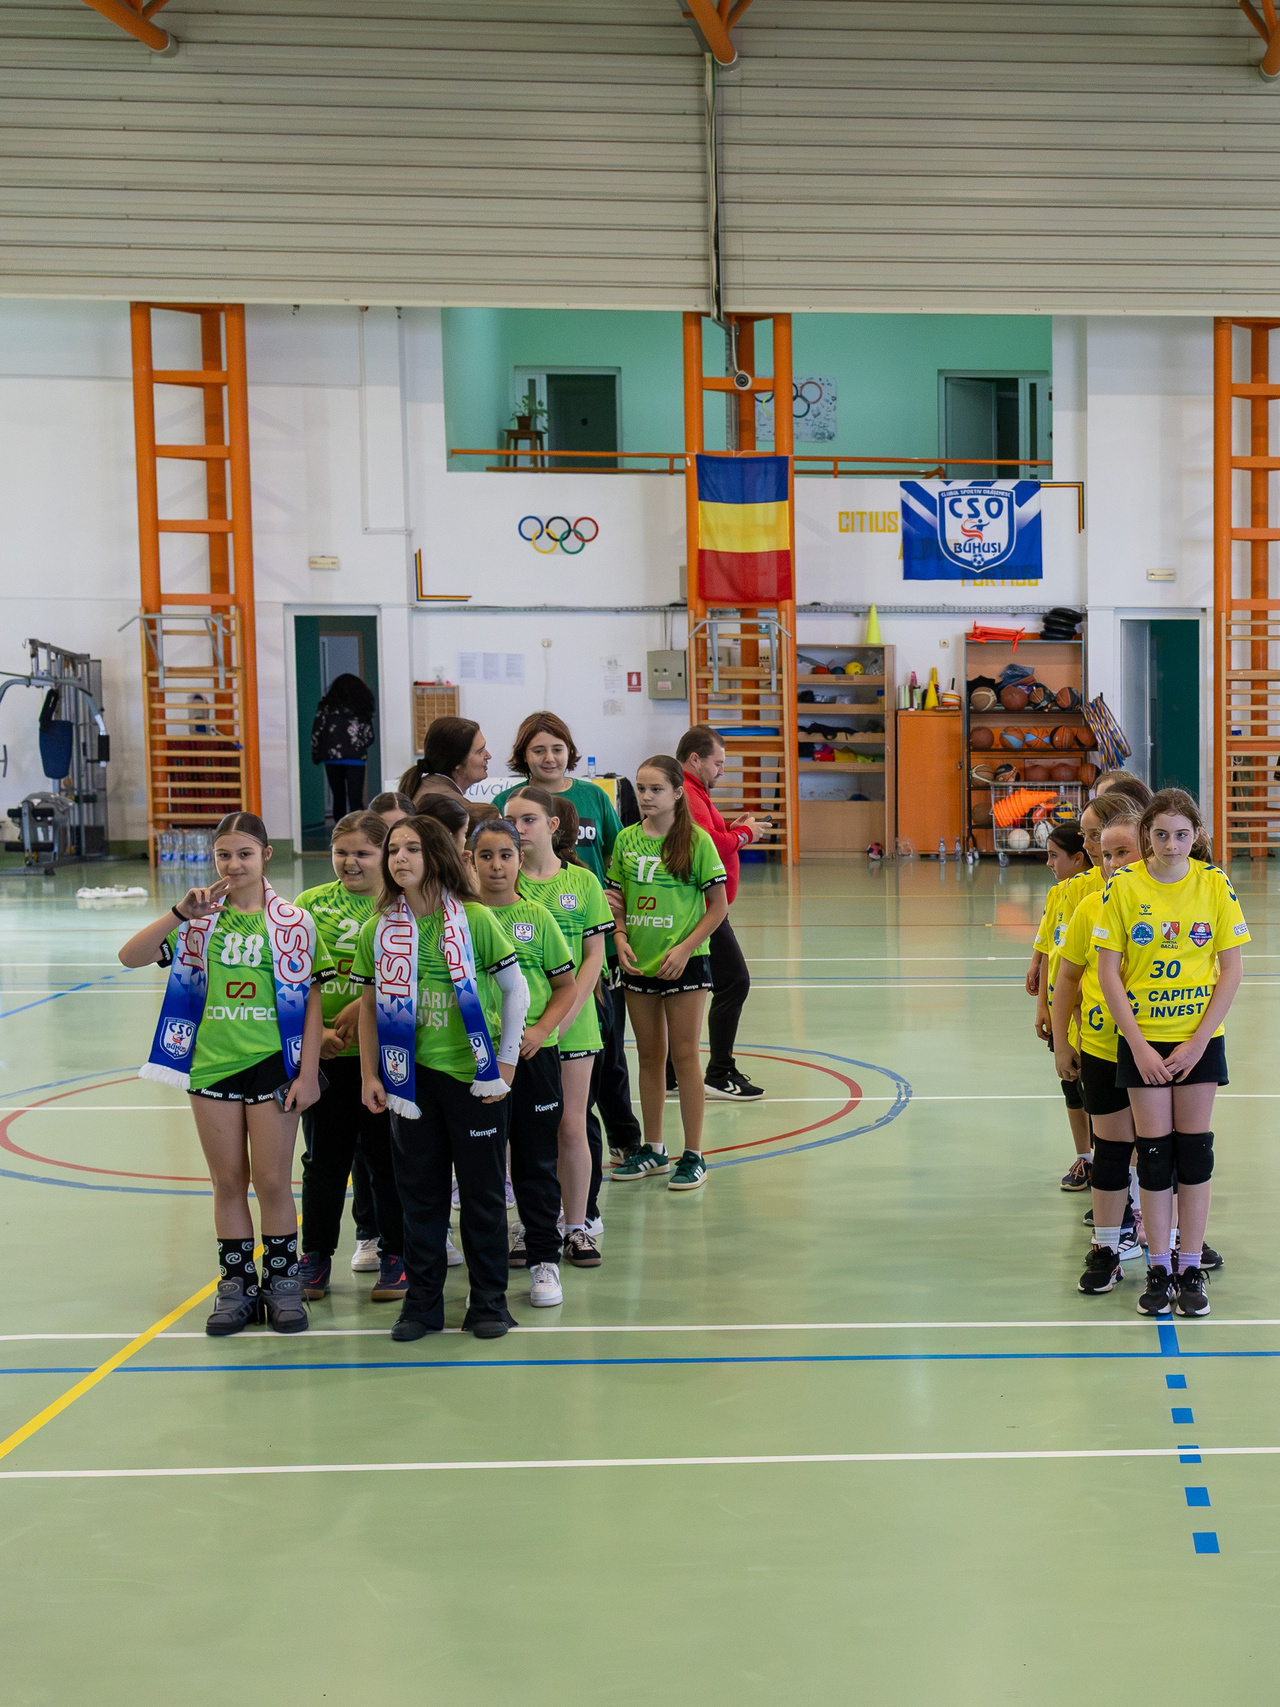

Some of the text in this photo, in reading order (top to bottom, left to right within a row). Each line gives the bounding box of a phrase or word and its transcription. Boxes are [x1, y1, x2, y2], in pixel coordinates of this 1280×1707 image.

[948, 497, 1003, 519] CSO
[838, 511, 898, 533] CITIUS
[636, 855, 662, 883] 17
[597, 921, 615, 931] Kempa
[267, 895, 313, 984] CSO
[220, 932, 264, 968] 88
[550, 963, 571, 976] Kempa
[1149, 959, 1181, 979] 30
[320, 980, 363, 996] ovir
[682, 983, 699, 992] Kempa
[1147, 985, 1211, 1002] CAPITAL
[1149, 1002, 1205, 1018] INVEST
[386, 1050, 405, 1063] CSO
[569, 1050, 588, 1059] Kempa
[200, 1087, 223, 1099] Kempa
[534, 1101, 559, 1112] Kempa
[469, 1126, 498, 1138] Kempa
